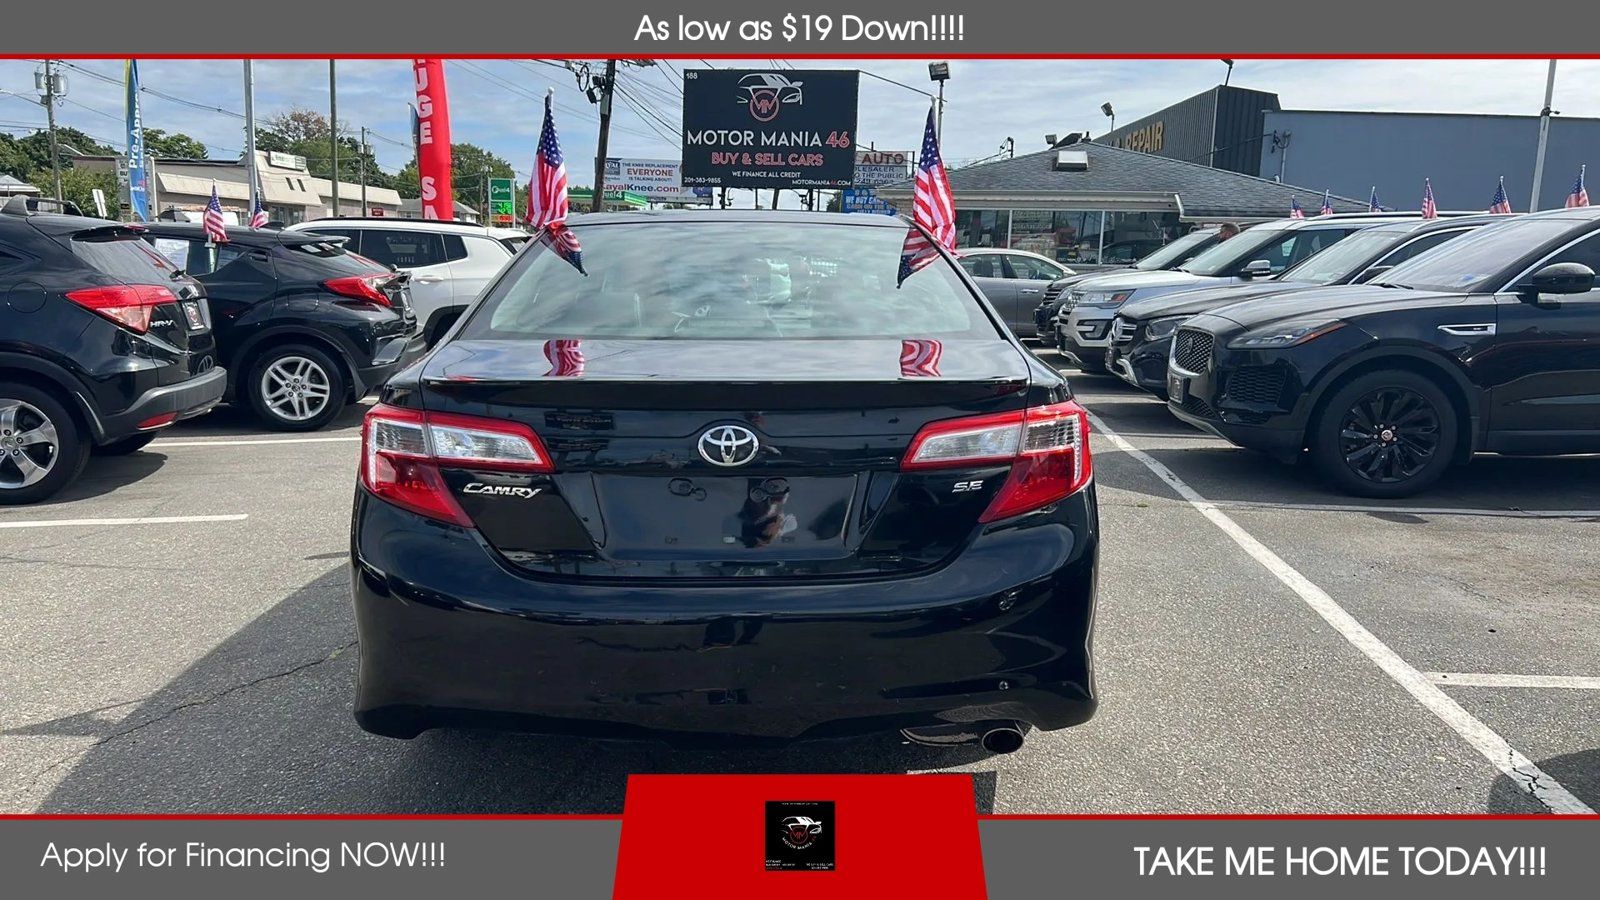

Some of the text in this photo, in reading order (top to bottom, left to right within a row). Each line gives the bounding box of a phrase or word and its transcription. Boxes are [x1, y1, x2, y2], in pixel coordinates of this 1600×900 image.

[412, 59, 433, 145] UGE
[687, 130, 850, 148] MOTOR MANIA 46
[711, 152, 824, 166] BUY & SELL CARS
[861, 153, 904, 165] AUTO
[627, 168, 674, 176] EVERYONE
[150, 320, 174, 328] HR-V
[463, 483, 542, 499] CAMRY
[952, 480, 984, 493] SE
